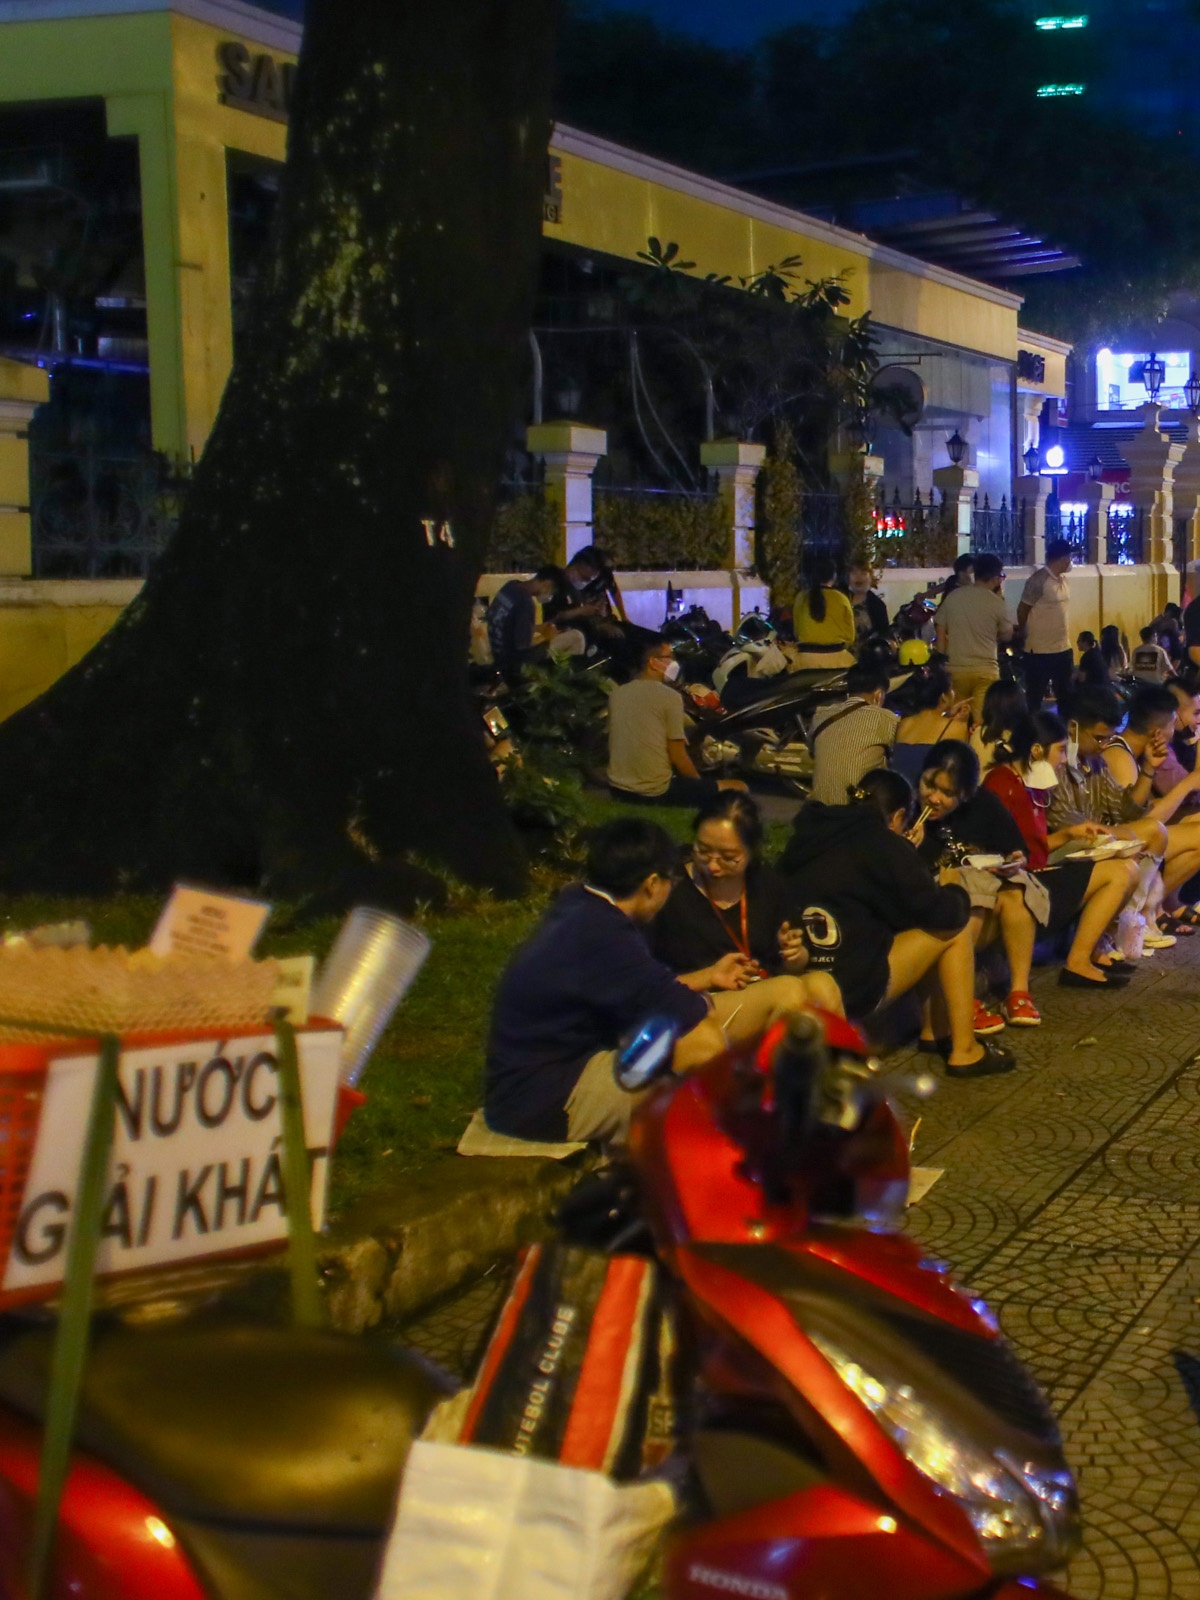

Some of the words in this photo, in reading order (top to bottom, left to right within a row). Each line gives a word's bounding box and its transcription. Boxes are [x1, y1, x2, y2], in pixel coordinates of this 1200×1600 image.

[13, 1163, 156, 1267] GẢI
[512, 1378, 550, 1457] UTEBOL
[538, 1306, 576, 1374] CLUBE
